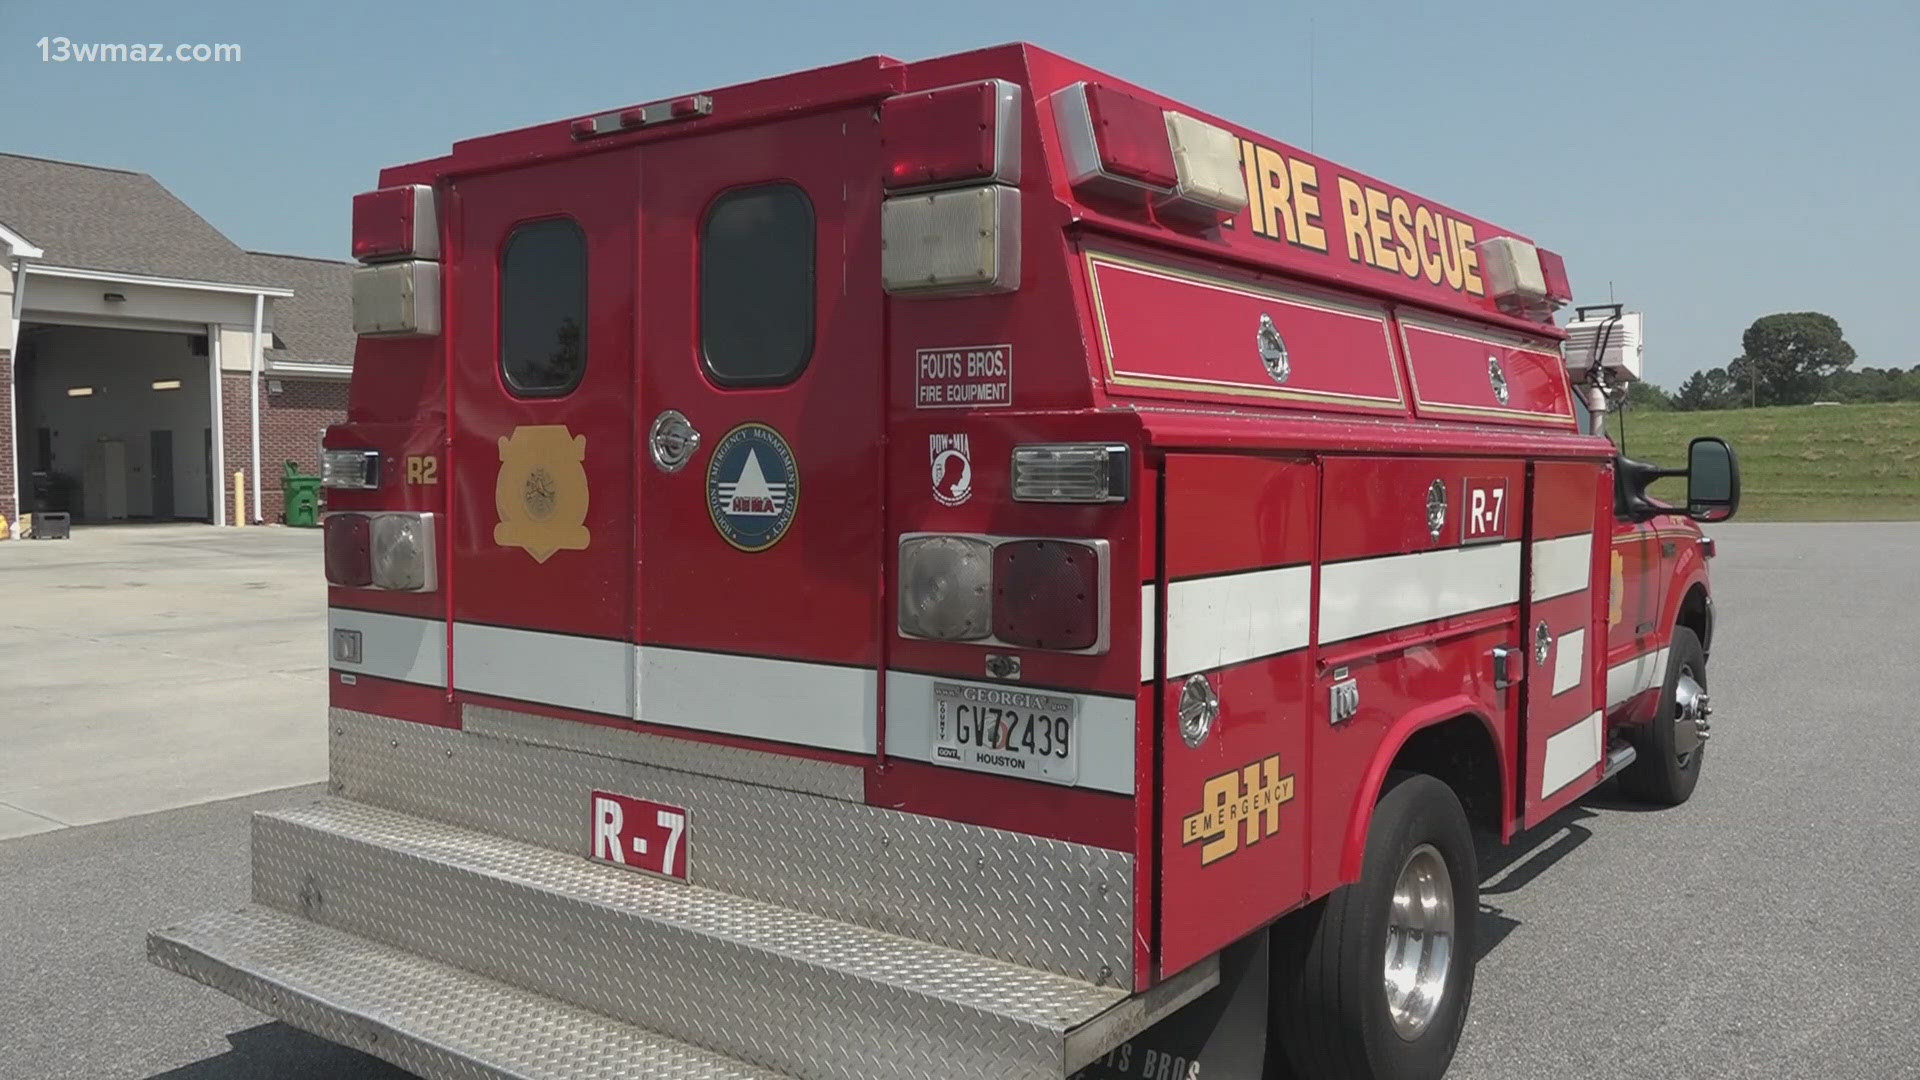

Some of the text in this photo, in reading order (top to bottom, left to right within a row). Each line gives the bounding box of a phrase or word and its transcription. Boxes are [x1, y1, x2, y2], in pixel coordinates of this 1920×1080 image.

[1222, 137, 1485, 296] IRE RESCUE
[921, 350, 1007, 379] FOUTS BROS.
[920, 383, 1007, 402] FIRE EQUIPMENT
[407, 456, 438, 484] R2
[753, 429, 795, 489] MANAGEMENT
[772, 493, 794, 536] AGENCY
[1471, 488, 1504, 535] R-7
[963, 687, 1044, 710] GEORGIA
[957, 704, 1069, 759] GV72439
[976, 753, 1026, 769] HOUSTON
[1190, 782, 1289, 836] EMERGENCY
[594, 797, 685, 875] R-7
